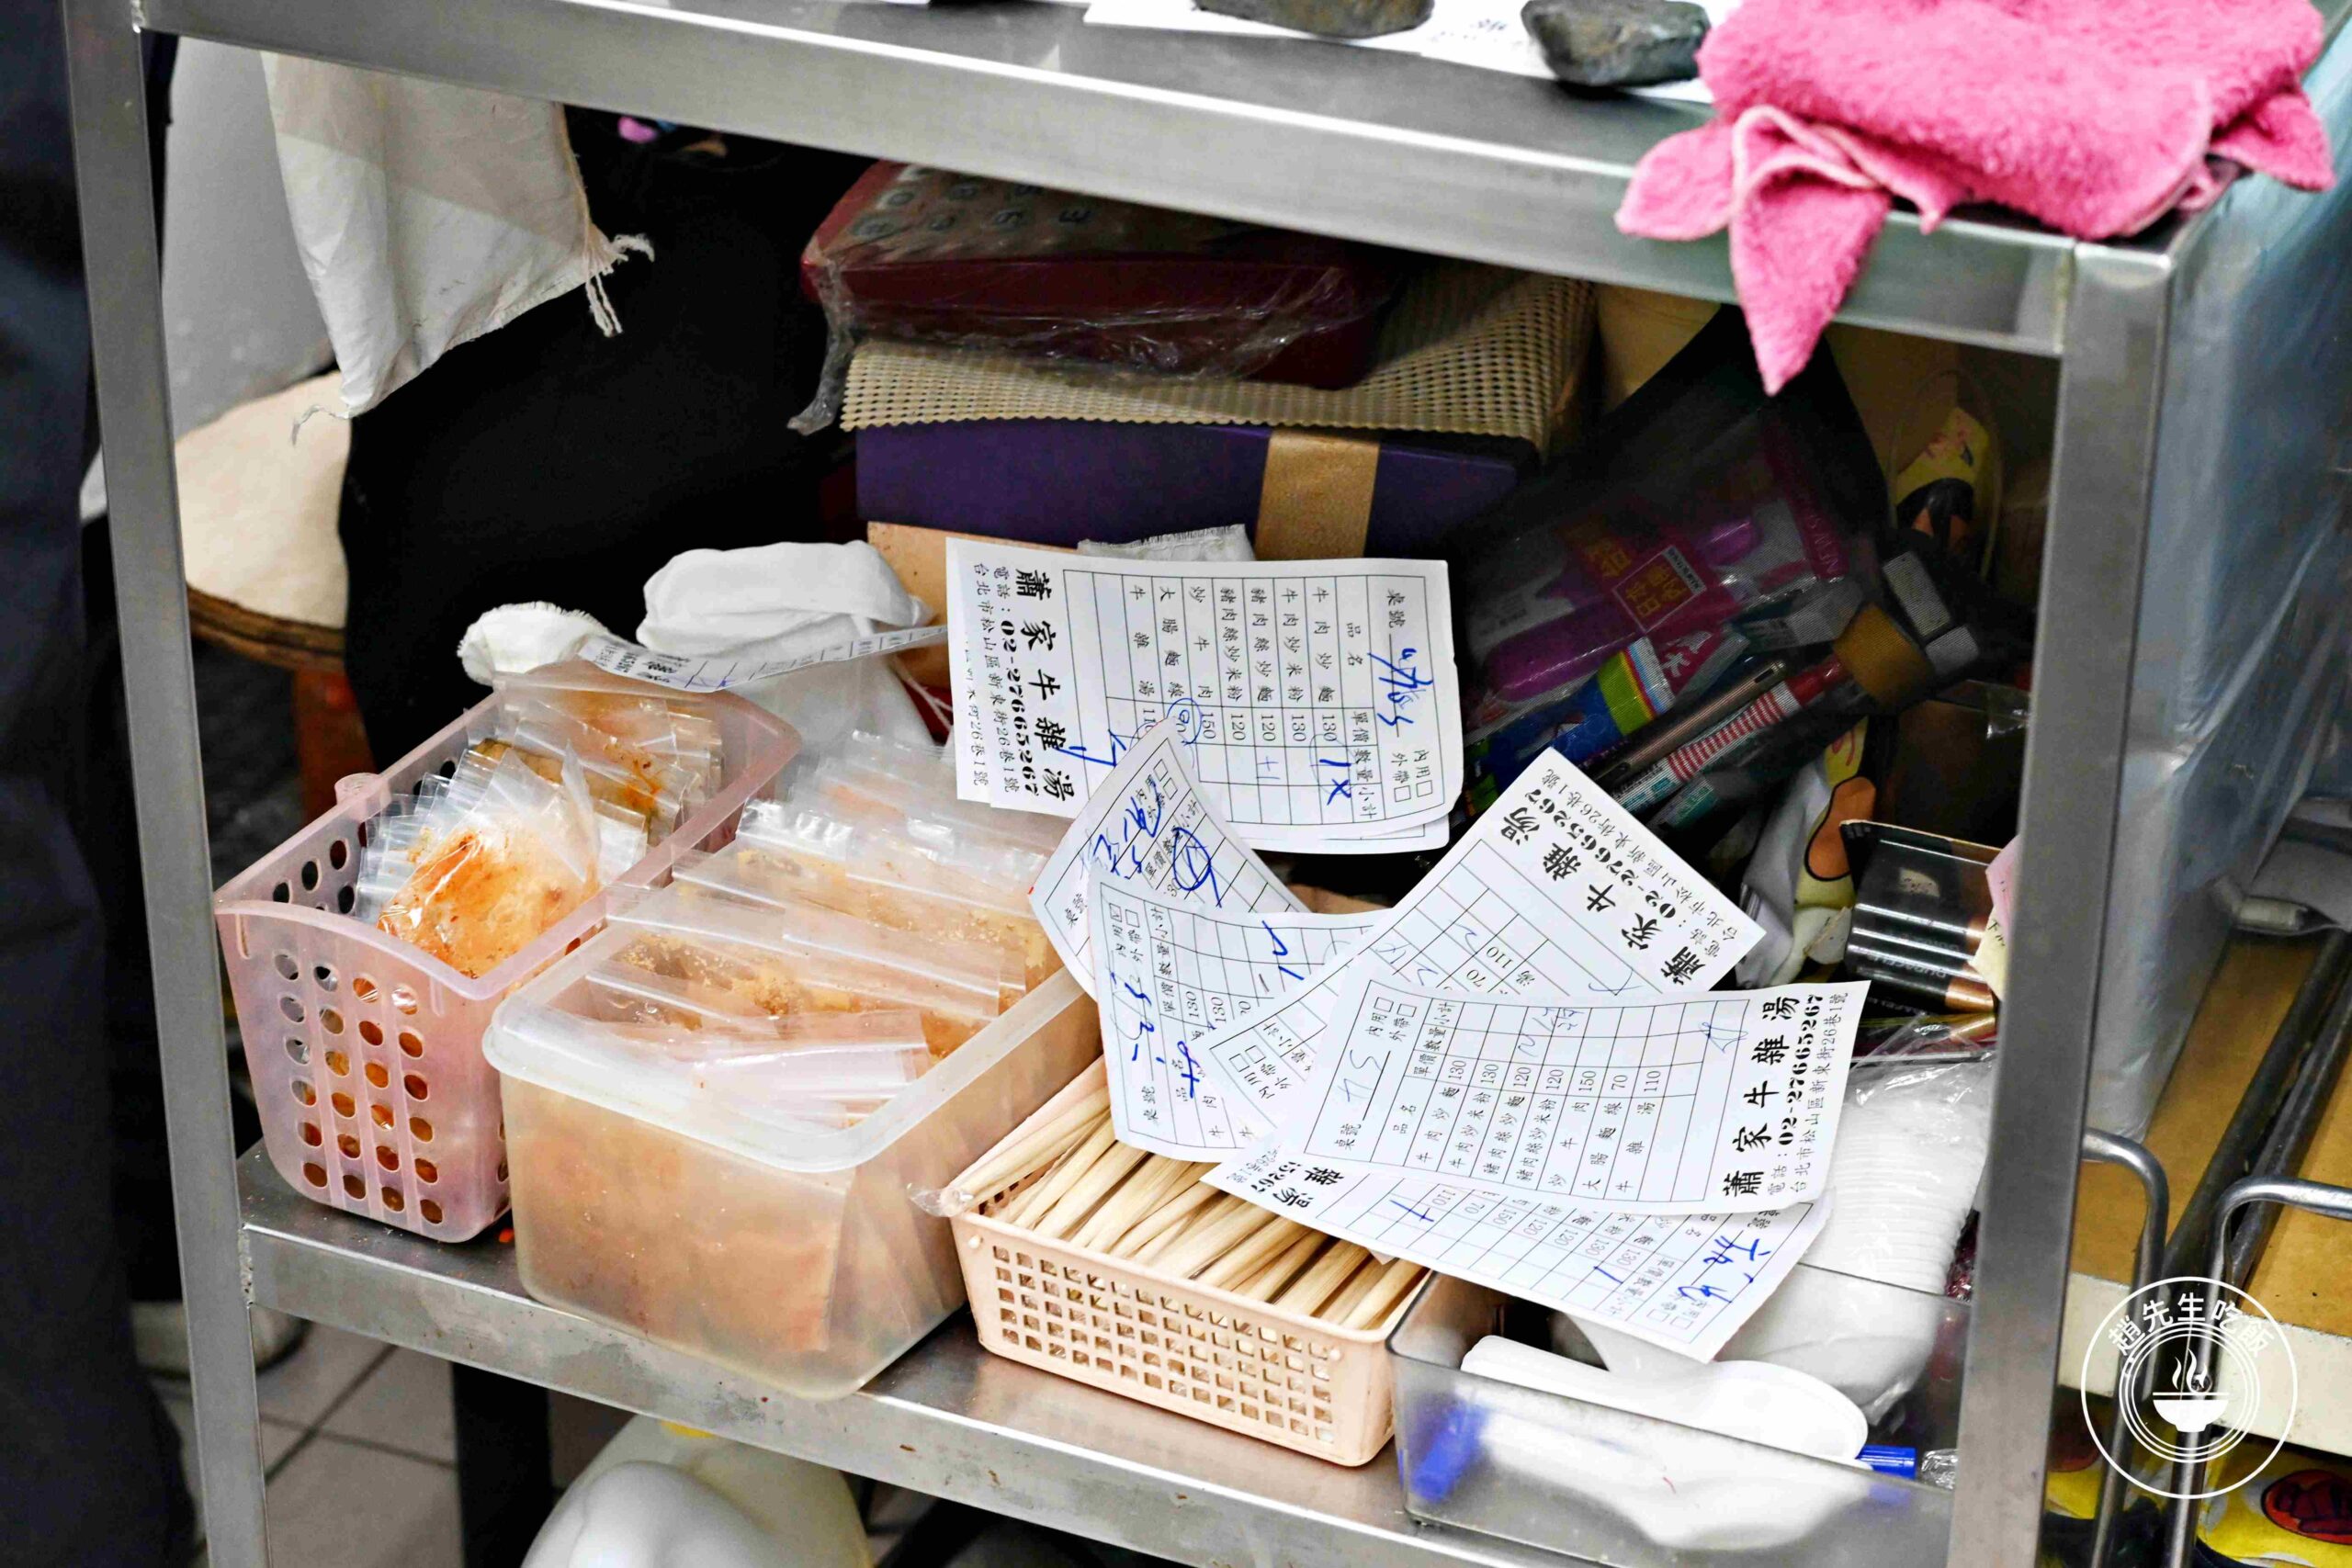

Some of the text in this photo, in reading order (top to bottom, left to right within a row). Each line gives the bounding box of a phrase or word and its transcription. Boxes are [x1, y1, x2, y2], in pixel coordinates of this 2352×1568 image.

[1385, 588, 1406, 628] 桌號
[1282, 588, 1305, 701] 牛肉炒米粉
[1312, 587, 1335, 703] 牛肉炒麵
[1346, 622, 1363, 666] 品名
[1015, 569, 1075, 801] 蕭家牛雜湯
[1201, 712, 1216, 739] 150
[1230, 714, 1246, 741] 120
[1261, 714, 1276, 742] 120
[1291, 714, 1306, 742] 130
[1321, 714, 1337, 742] 130
[1351, 711, 1369, 743] 單價
[1354, 749, 1374, 782] 數量
[1391, 752, 1411, 784] 外帶
[1414, 750, 1430, 779] 內用
[1359, 786, 1377, 819] 小計
[1163, 878, 1182, 897] 30
[1150, 905, 1169, 939] 小計
[1112, 924, 1127, 958] 內用
[1127, 929, 1144, 963] 外帶
[1156, 942, 1172, 976] 數量
[1486, 946, 1514, 969] 110
[1465, 969, 1487, 987] 70
[1160, 981, 1177, 1013] 單價
[1185, 991, 1200, 1019] 130
[1211, 997, 1227, 1023] 130
[1365, 1012, 1387, 1038] 內用
[1433, 1001, 1456, 1025] 小計
[1388, 1017, 1410, 1043] 外帶
[1423, 1026, 1447, 1052] 數量
[1260, 1064, 1293, 1089] 外帶
[1413, 1054, 1437, 1077] 單價
[1448, 1059, 1467, 1081] 130
[1480, 1064, 1499, 1085] 130
[1512, 1066, 1532, 1088] 120
[1244, 1072, 1275, 1100] 內用
[1545, 1069, 1565, 1090] 120
[1577, 1070, 1597, 1092] 150
[1611, 1075, 1629, 1091] 70
[1643, 1070, 1661, 1093] 110
[1791, 992, 1849, 1193] 台北市松山區新東街26巷1號
[1723, 997, 1801, 1197] 蕭家牛雜湯
[1392, 1104, 1417, 1134] 品名
[1334, 1122, 1362, 1151] 桌號
[1431, 1190, 1456, 1206] 110
[1464, 1201, 1486, 1214] 70
[1492, 1209, 1517, 1225] 150
[1522, 1219, 1547, 1236] 120
[1554, 1228, 1578, 1247] 120
[1585, 1238, 1610, 1257] 130
[1616, 1248, 1641, 1266] 130
